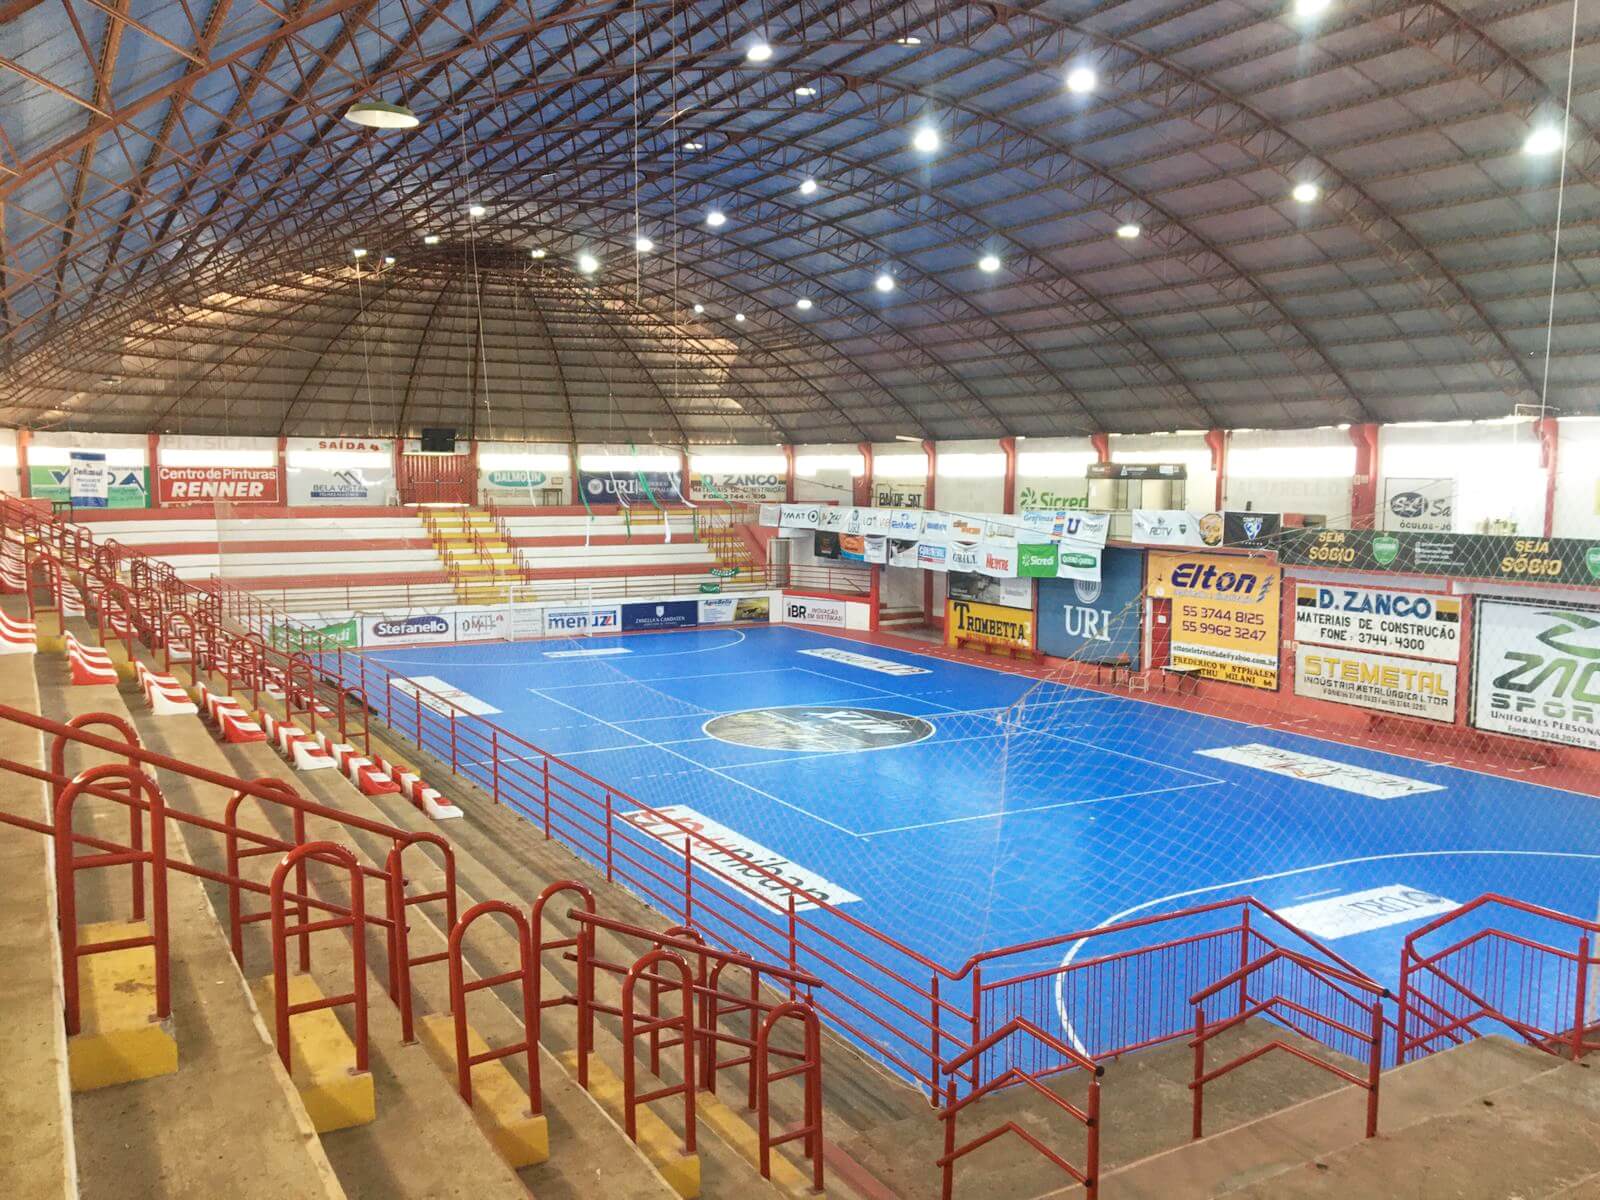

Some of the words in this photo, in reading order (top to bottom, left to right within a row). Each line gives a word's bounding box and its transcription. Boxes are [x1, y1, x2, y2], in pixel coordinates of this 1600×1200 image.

[319, 439, 365, 450] SAÍDA
[160, 468, 207, 480] Centro
[208, 468, 222, 480] de
[222, 468, 276, 480] Pinturas
[723, 474, 777, 486] ZANCO
[171, 482, 264, 497] RENNER
[605, 479, 635, 494] URI
[1319, 531, 1345, 543] SEJA
[1515, 540, 1550, 553] SEJA
[1171, 563, 1257, 594] Elton
[1319, 588, 1340, 610] D.
[1343, 590, 1432, 620] ZANCO
[953, 602, 1026, 641] TROMBETTA
[1063, 604, 1112, 642] URI
[1183, 605, 1197, 617] 55
[1201, 607, 1231, 621] 3744
[1235, 611, 1264, 626] 8125
[1297, 611, 1351, 627] MATERIAIS
[1358, 618, 1373, 630] DE
[377, 618, 448, 635] Stefanello
[1182, 620, 1197, 632] 55
[1200, 622, 1231, 637] 9962
[1234, 627, 1266, 641] 3247
[1304, 654, 1449, 697] STEMETAL
